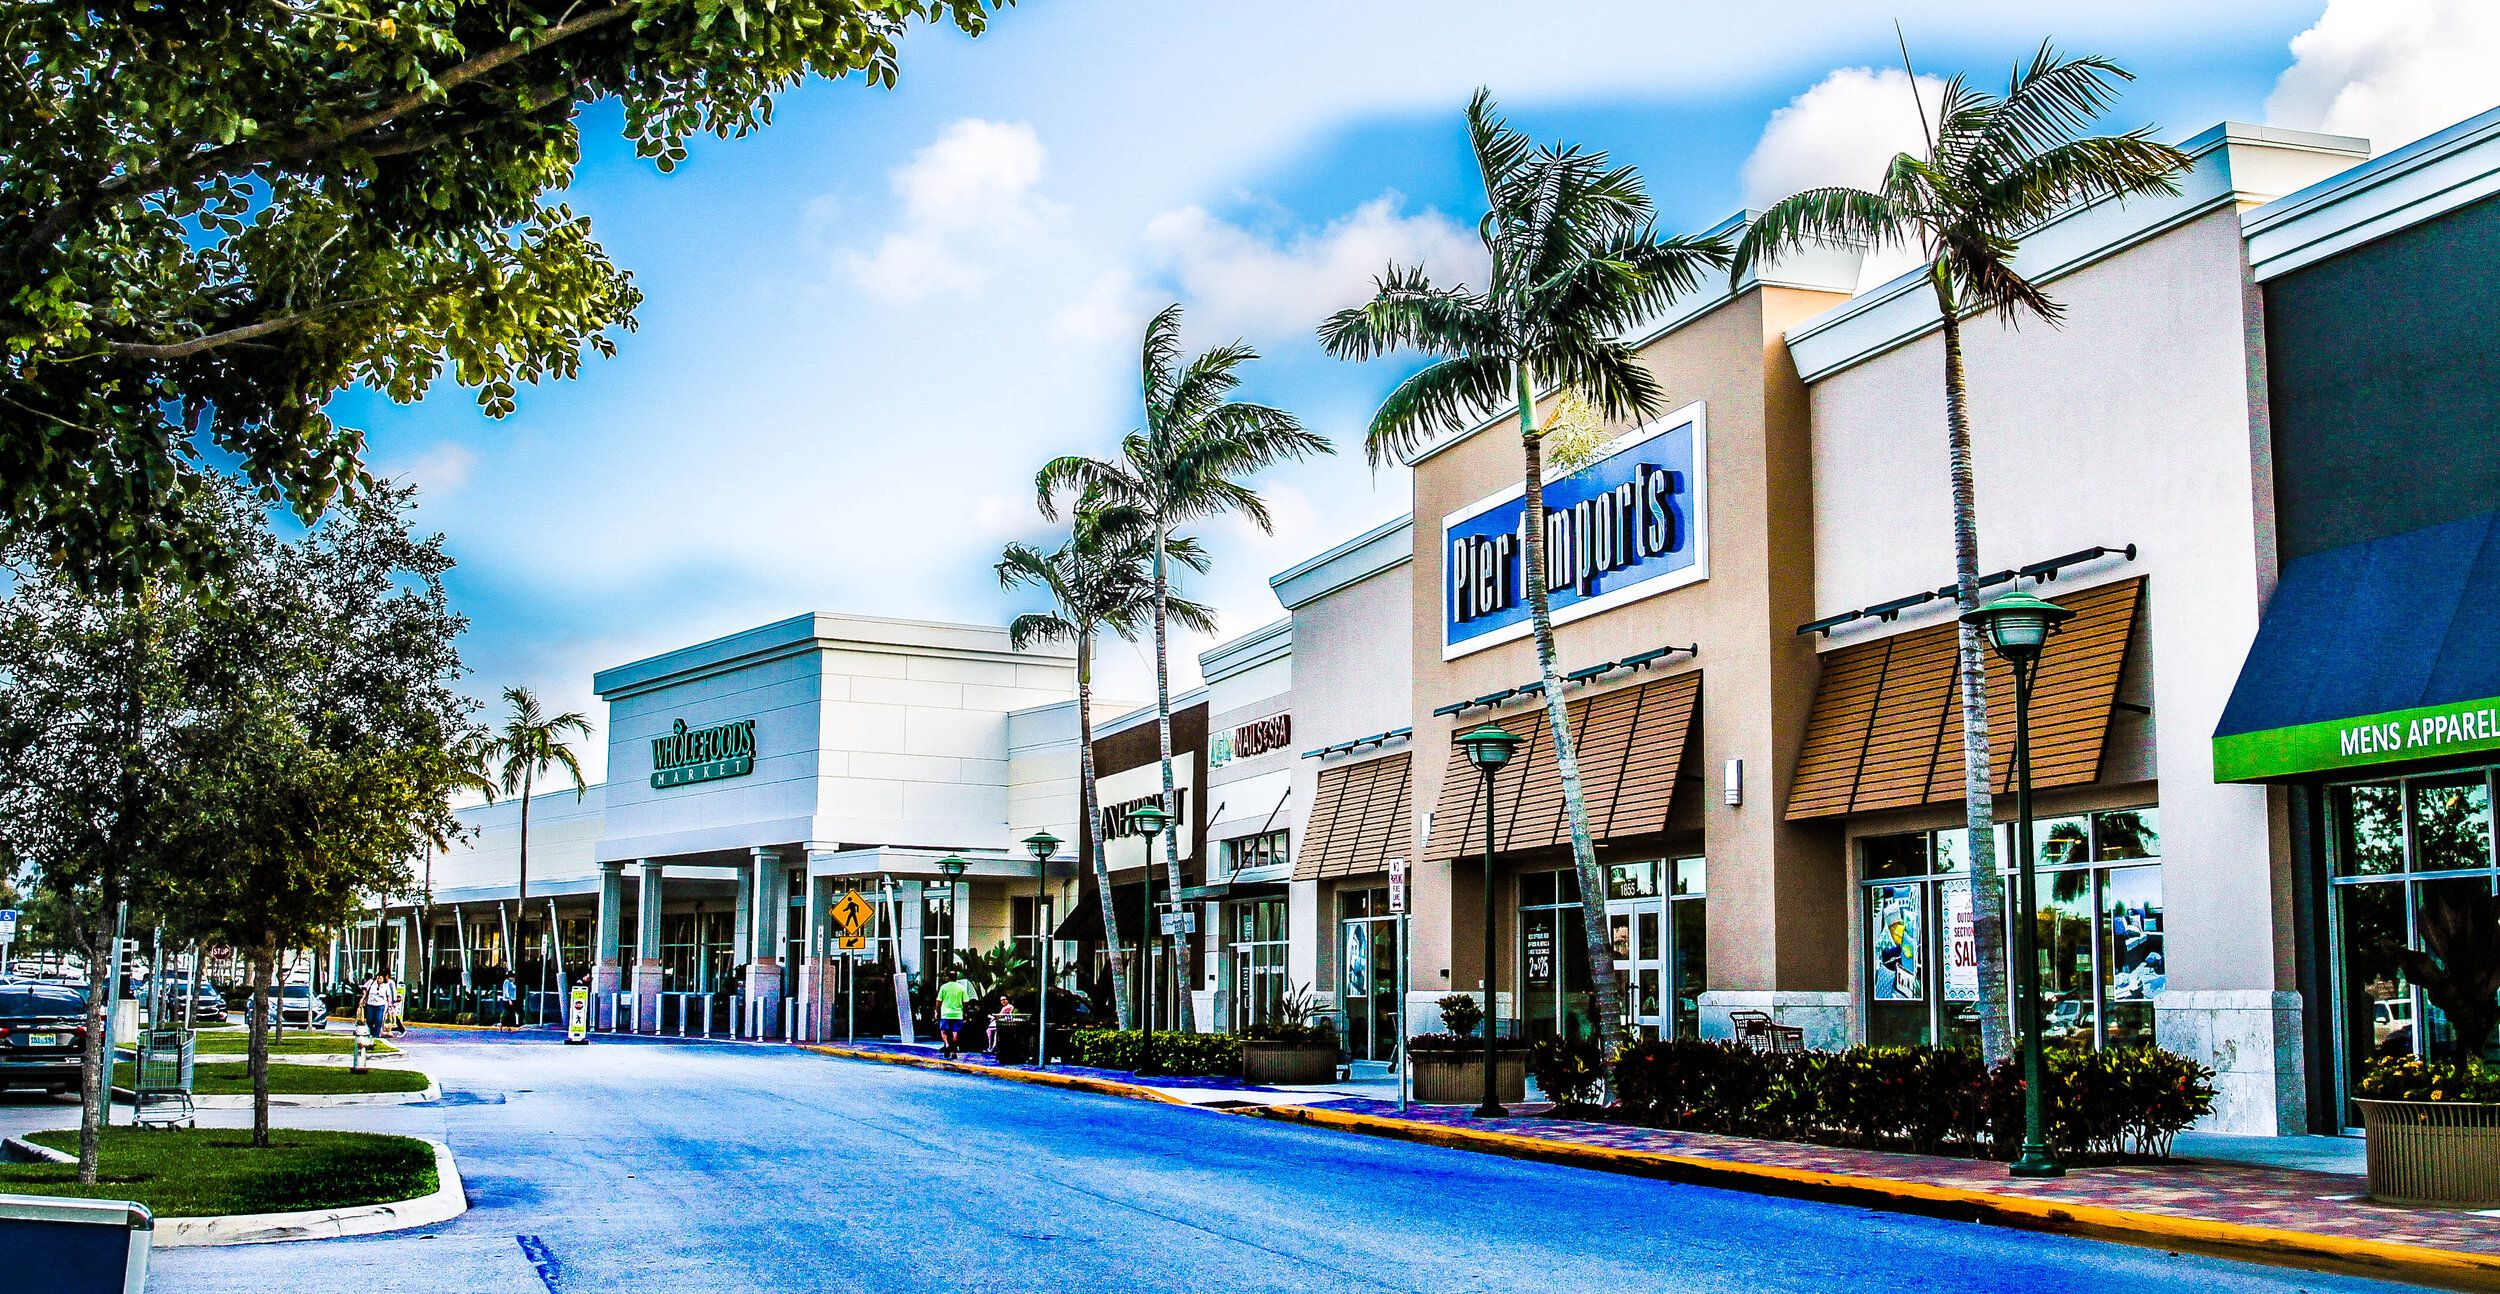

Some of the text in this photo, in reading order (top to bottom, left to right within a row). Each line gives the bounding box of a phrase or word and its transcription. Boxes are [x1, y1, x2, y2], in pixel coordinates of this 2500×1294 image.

[1453, 463, 1667, 624] Pier 1 mports
[651, 720, 754, 770] WHOLE FOODS
[2340, 708, 2500, 757] MENS APPAREL
[657, 761, 741, 785] MARKET
[1620, 882, 1635, 896] 1855
[1955, 940, 1977, 967] SAL
